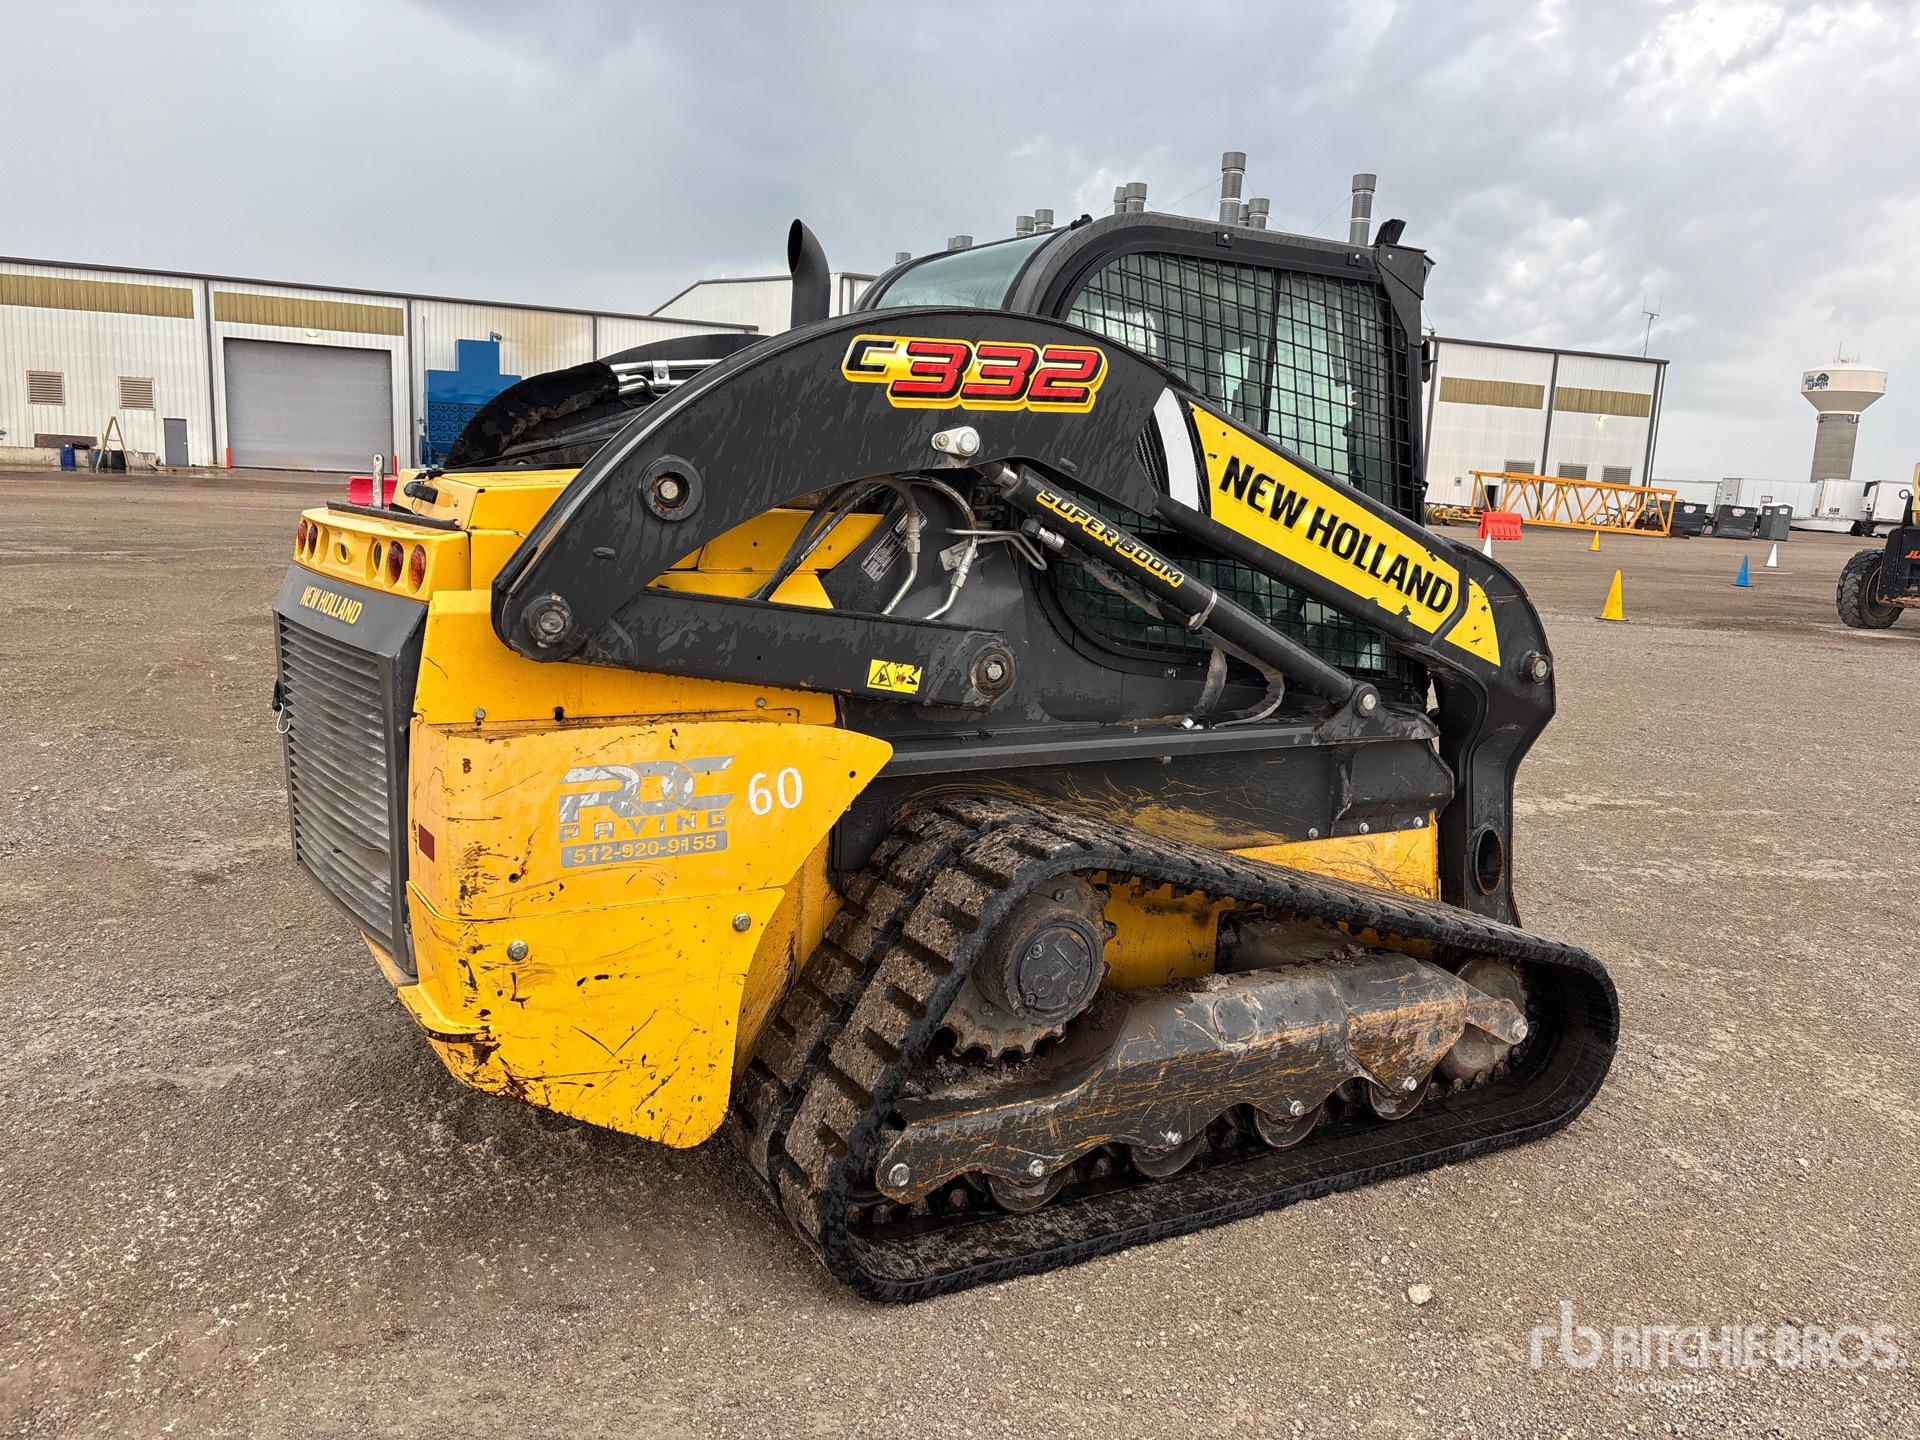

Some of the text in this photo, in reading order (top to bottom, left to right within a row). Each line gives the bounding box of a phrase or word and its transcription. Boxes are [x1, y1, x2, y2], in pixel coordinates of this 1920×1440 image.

[843, 335, 1108, 412] C332
[1036, 490, 1184, 588] SUPER BOOM
[1218, 454, 1454, 614] NEW HOLLAND
[299, 585, 363, 625] NEW HOLLAND
[558, 755, 737, 824] RDC
[748, 766, 803, 816] 60
[559, 810, 727, 844] PAVING
[573, 833, 718, 864] 512-920-9155
